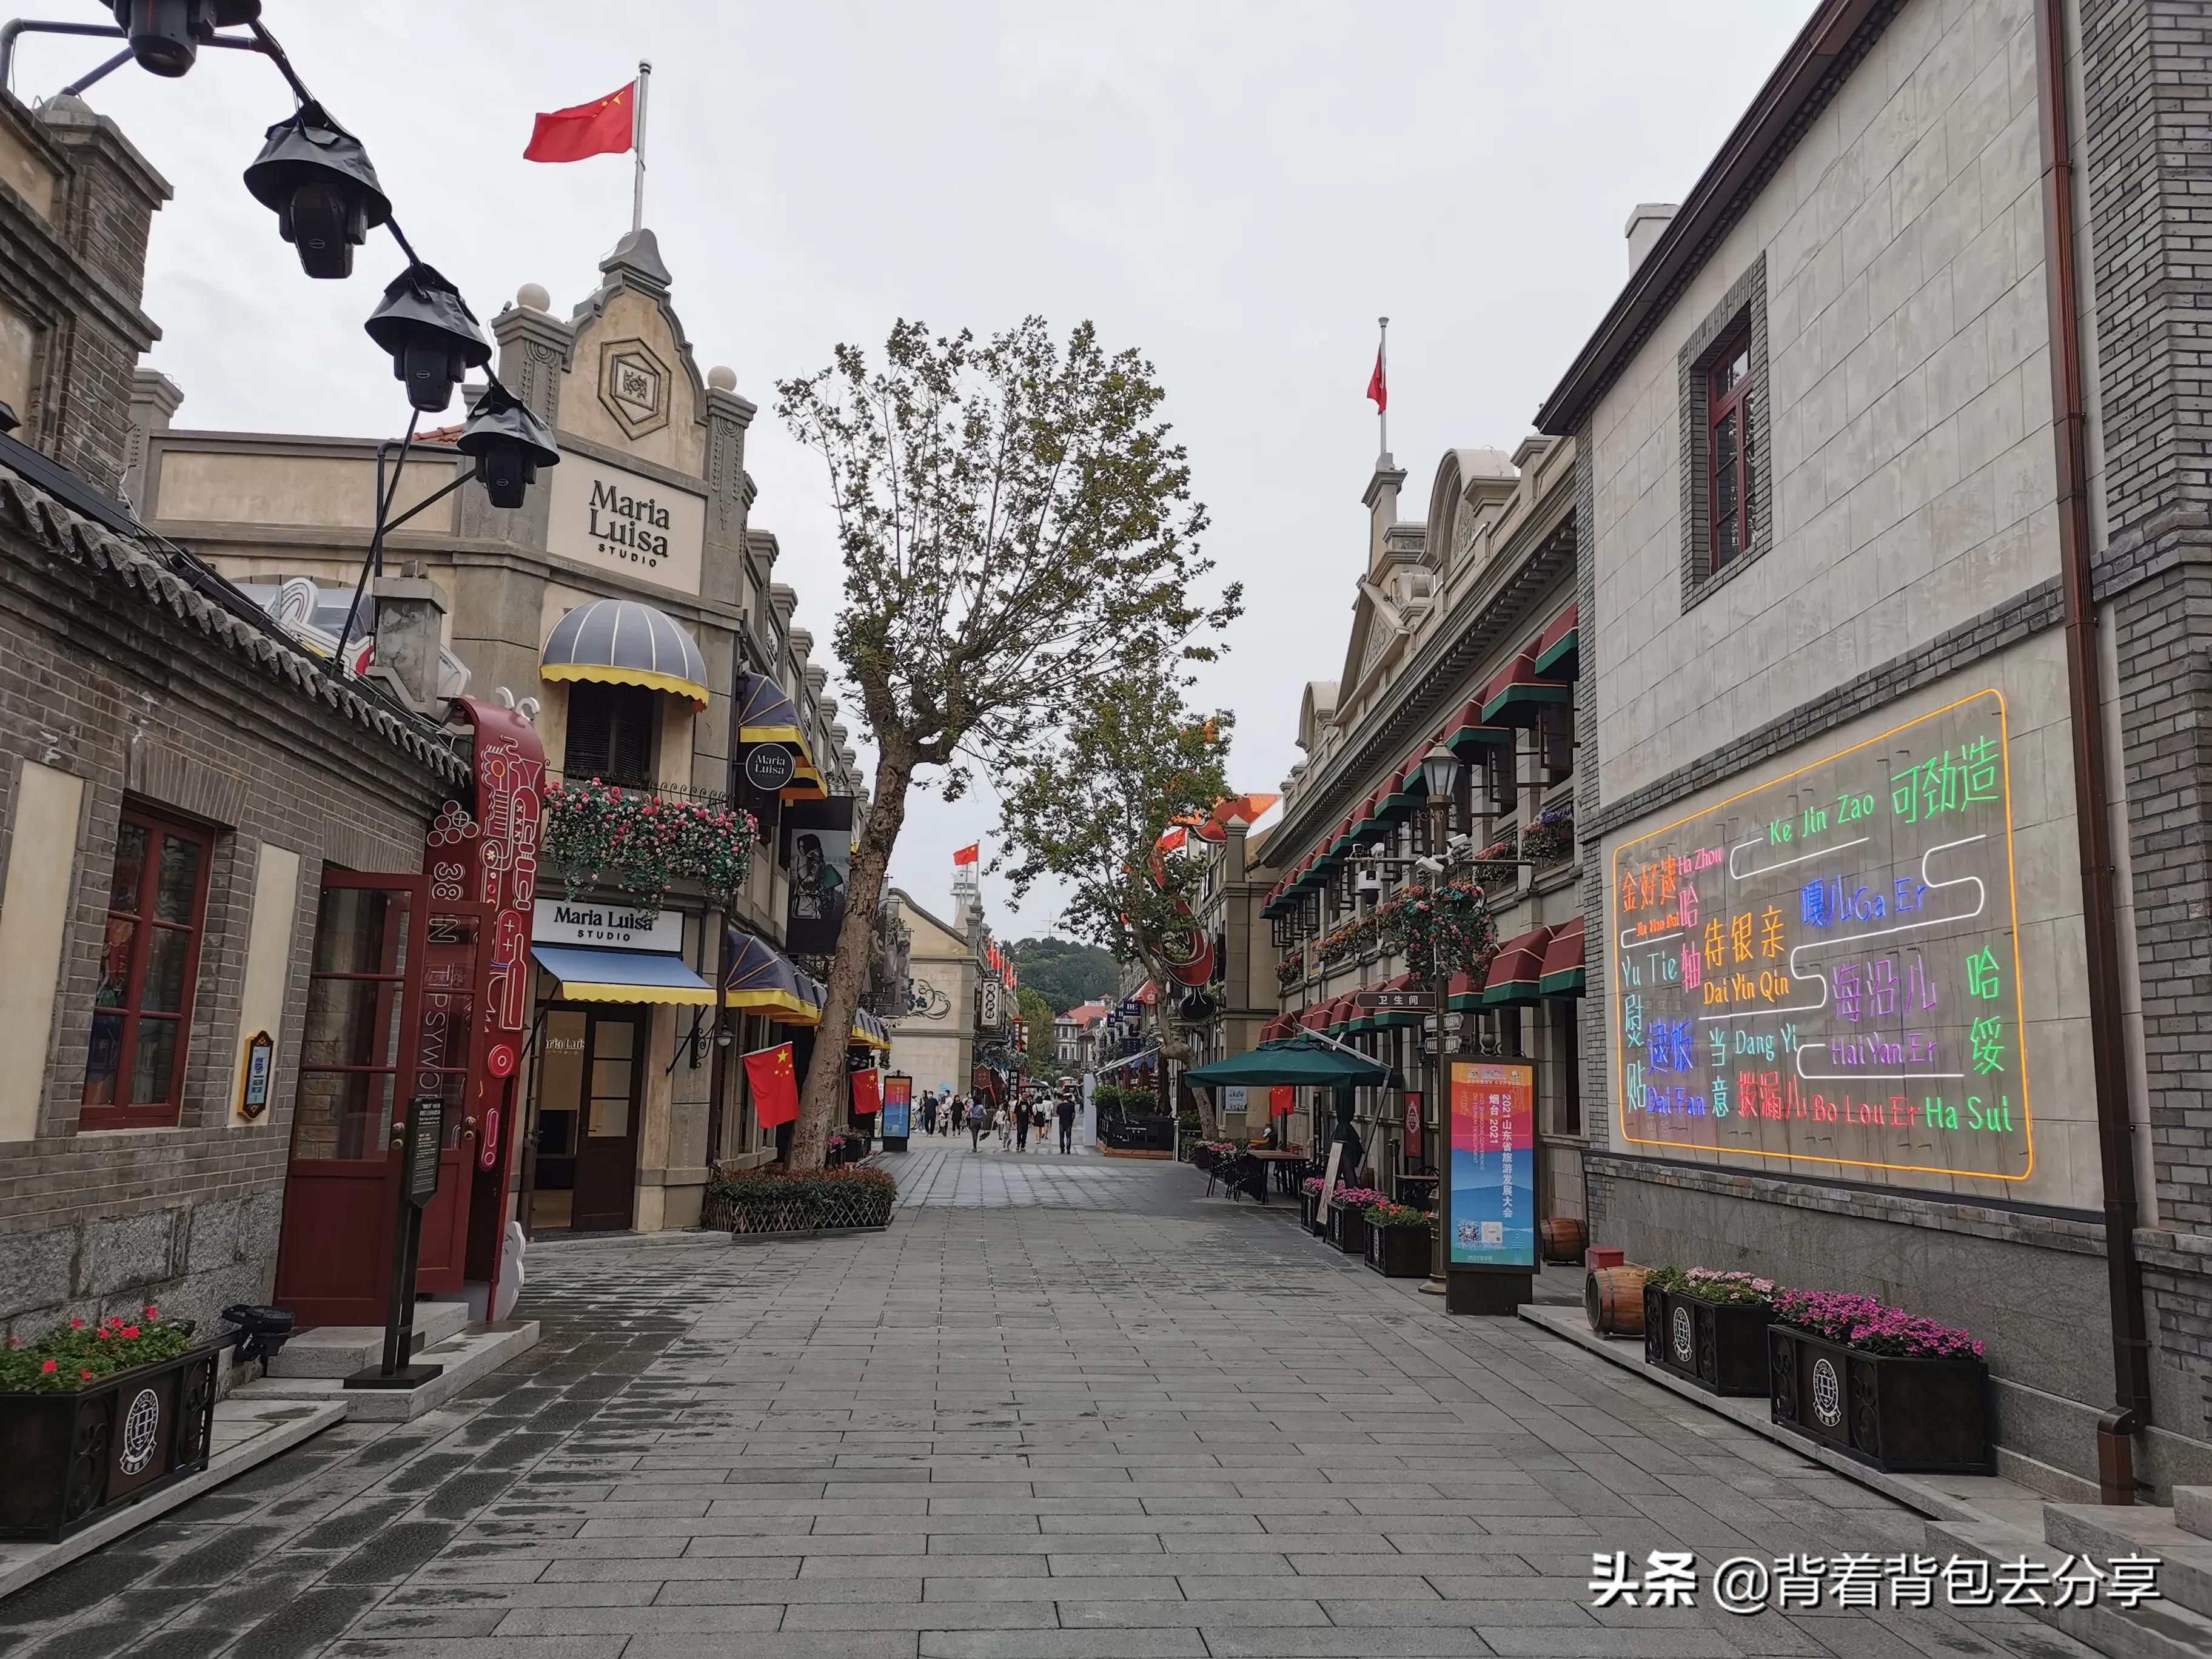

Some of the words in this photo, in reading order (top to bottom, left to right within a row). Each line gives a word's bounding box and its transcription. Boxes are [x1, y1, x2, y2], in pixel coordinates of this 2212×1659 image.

[589, 480, 670, 530] Maria
[588, 508, 669, 557] Luisa
[598, 543, 657, 568] STUDIO
[755, 754, 785, 766] Maria
[755, 764, 784, 774] Luisa
[1891, 736, 2000, 823] 可劲造
[1770, 819, 1792, 845] Ke
[1801, 806, 1827, 837] Jin
[1837, 794, 1874, 823] Zao
[1678, 857, 1692, 875] Ha
[1695, 848, 1722, 870] Zhou
[432, 862, 465, 900] 38
[1854, 886, 1886, 921] Ga
[1895, 877, 1927, 912] Er
[554, 907, 602, 927] Maria
[608, 911, 652, 931] Luisa
[1800, 875, 1852, 927] 嘎儿
[577, 930, 631, 941] STUDIO
[1704, 905, 1785, 970] 待银亲
[1621, 956, 1641, 987] Yu
[1647, 950, 1677, 983] Tie
[1378, 996, 1418, 1005] 卫生间
[1704, 978, 1729, 1005] Dai
[1732, 973, 1755, 1001] Yin
[1761, 970, 1789, 1002] Qin
[1832, 954, 1937, 1022] 海沿儿
[1966, 945, 2005, 1074] 哈绥
[418, 965, 450, 1098] TIPSYWO
[1735, 1030, 1775, 1061] Dang
[1781, 1023, 1798, 1053] Yi
[1832, 1037, 1865, 1065] Hai
[1866, 1031, 1902, 1065] Yan
[1909, 1033, 1937, 1063] Er
[1709, 1027, 1729, 1118] 当意
[1647, 1087, 1672, 1114] Dai
[1675, 1088, 1705, 1116] Fan
[1812, 1094, 1837, 1124] Bo
[1846, 1095, 1884, 1125] Lou
[1891, 1096, 1920, 1126] Er
[1926, 1096, 1959, 1130] Ha
[1968, 1095, 2013, 1132] Sui
[1490, 1119, 1499, 1144] 2021
